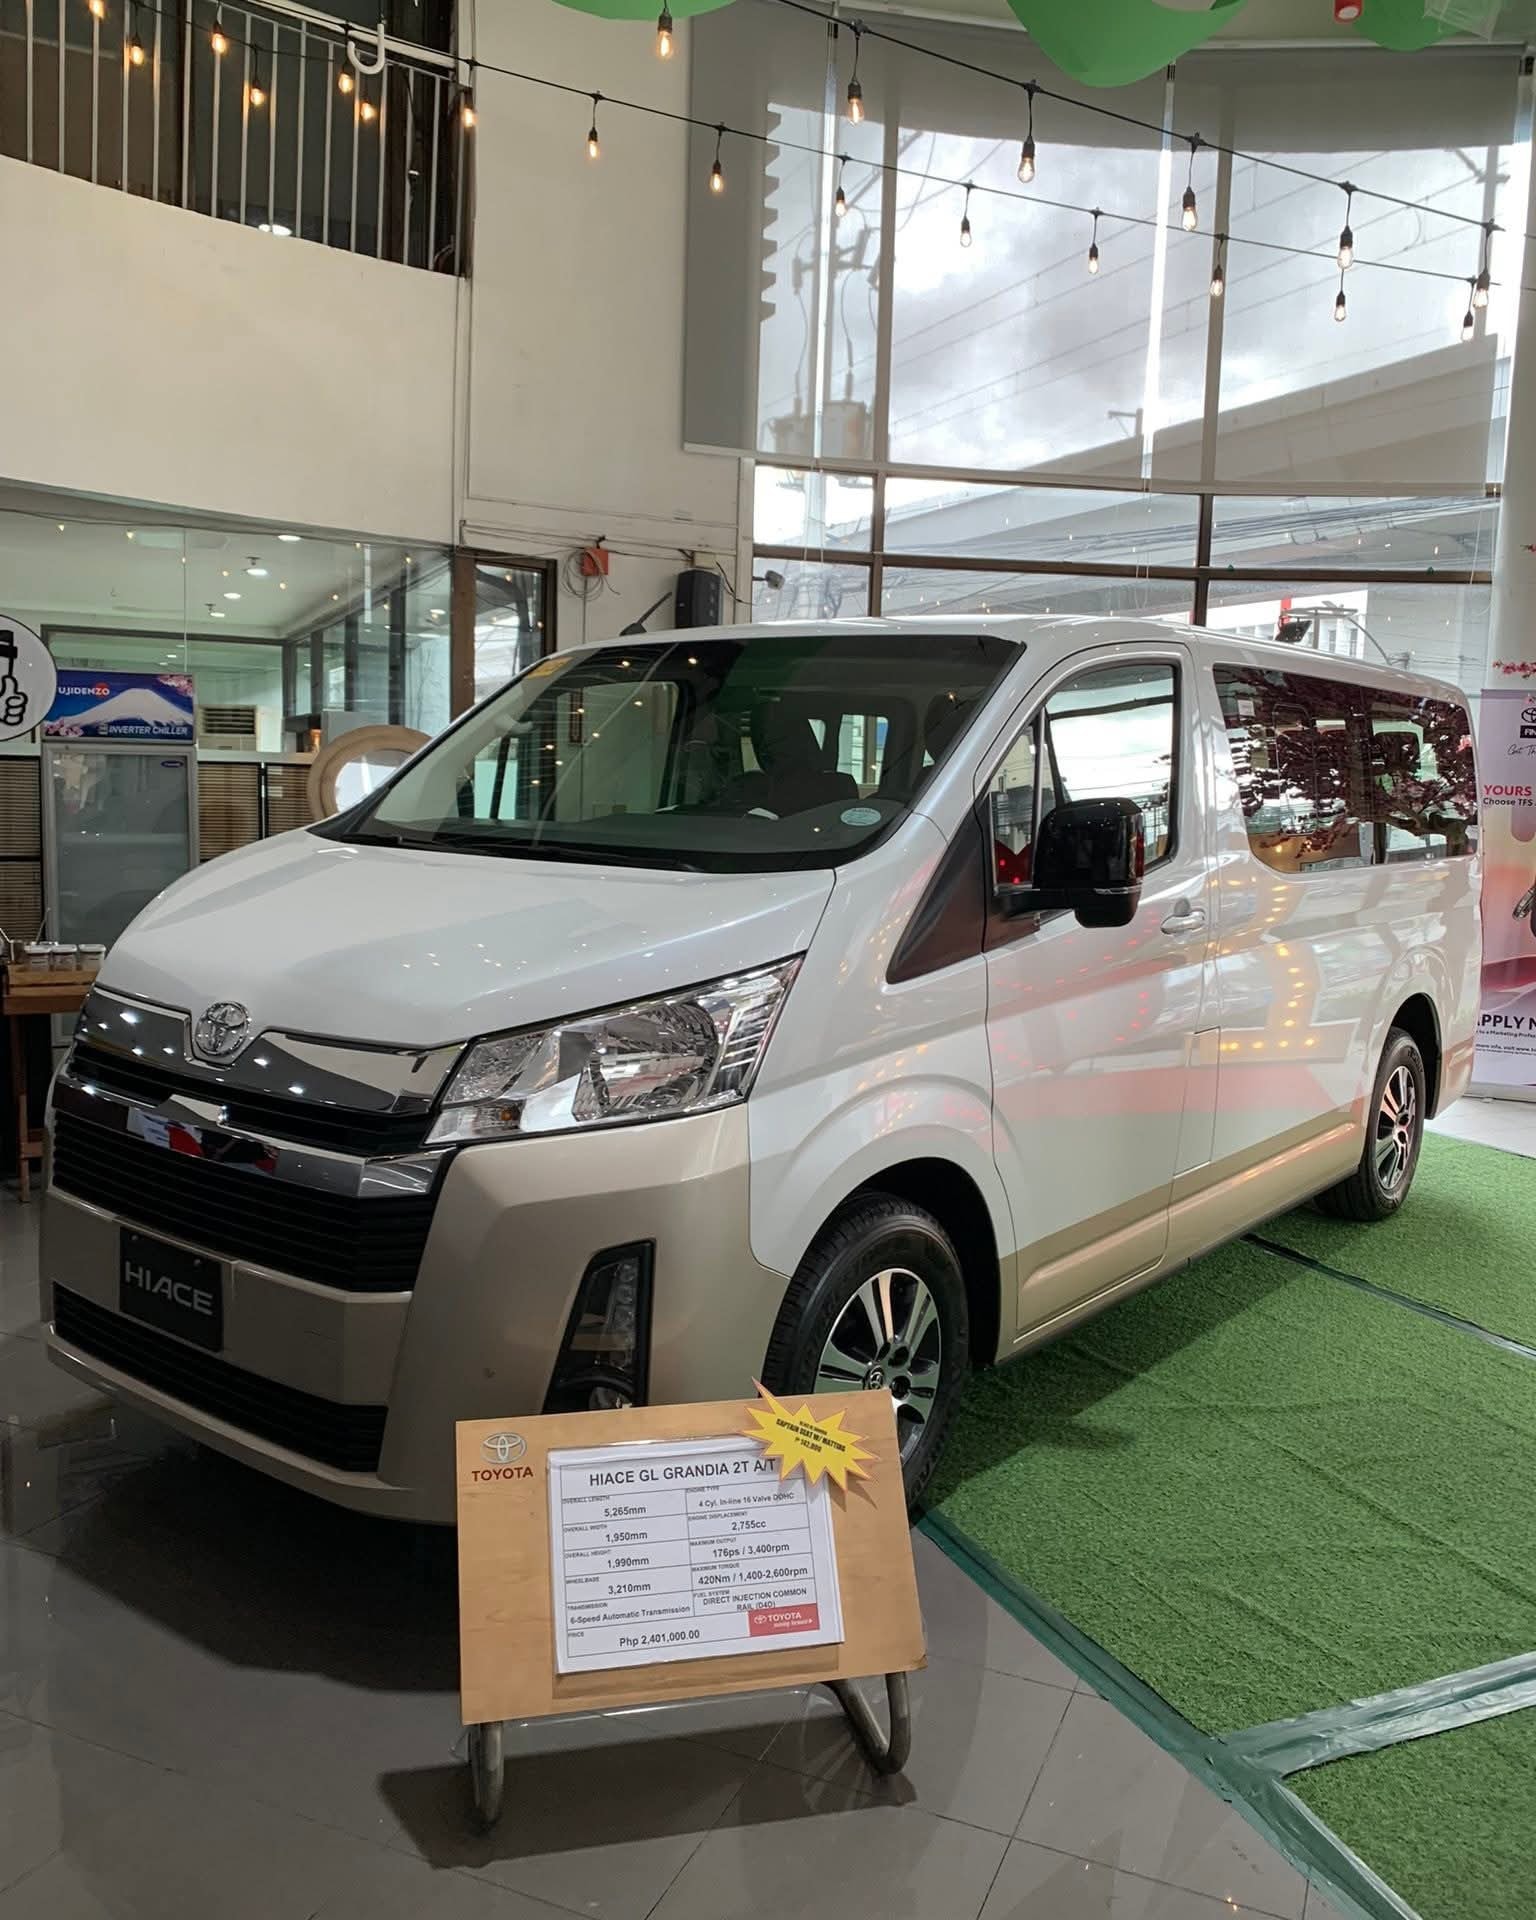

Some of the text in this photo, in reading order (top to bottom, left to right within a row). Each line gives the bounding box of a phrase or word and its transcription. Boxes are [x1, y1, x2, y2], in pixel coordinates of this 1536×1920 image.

[109, 726, 188, 736] INVERTER CHILLER
[1484, 785, 1532, 796] YOURS
[1483, 798, 1533, 807] Choose TFS
[125, 1261, 213, 1316] HIACE
[471, 1466, 534, 1482] TOYOTA
[590, 1459, 776, 1486] HIACE GL GRANDIA 2T A/T
[705, 1499, 718, 1508] Cyl.
[720, 1498, 741, 1506] In-line
[743, 1496, 751, 1504] 16
[752, 1495, 771, 1503] Valve
[773, 1492, 794, 1500] DOHC
[604, 1506, 646, 1518] 5,265mm
[709, 1511, 748, 1520] DISPLACEMENT
[731, 1520, 767, 1531] 2,755cc
[606, 1531, 648, 1543] 1,950mm
[712, 1548, 740, 1558] 176ps
[747, 1543, 790, 1555] 3,400rpm
[607, 1557, 650, 1569] 1,990mm
[698, 1575, 731, 1585] 420Nm
[739, 1566, 808, 1582] 1,400-2,600rpm
[608, 1583, 651, 1595] 3,210mm
[703, 1587, 807, 1606] DIRECT INJECTION COMMON
[736, 1603, 753, 1611] RAIL
[570, 1606, 690, 1625] 6-Speed Automatic Transmission
[768, 1611, 802, 1622] TOYOTA
[619, 1629, 700, 1648] Php 2,401,000.00
